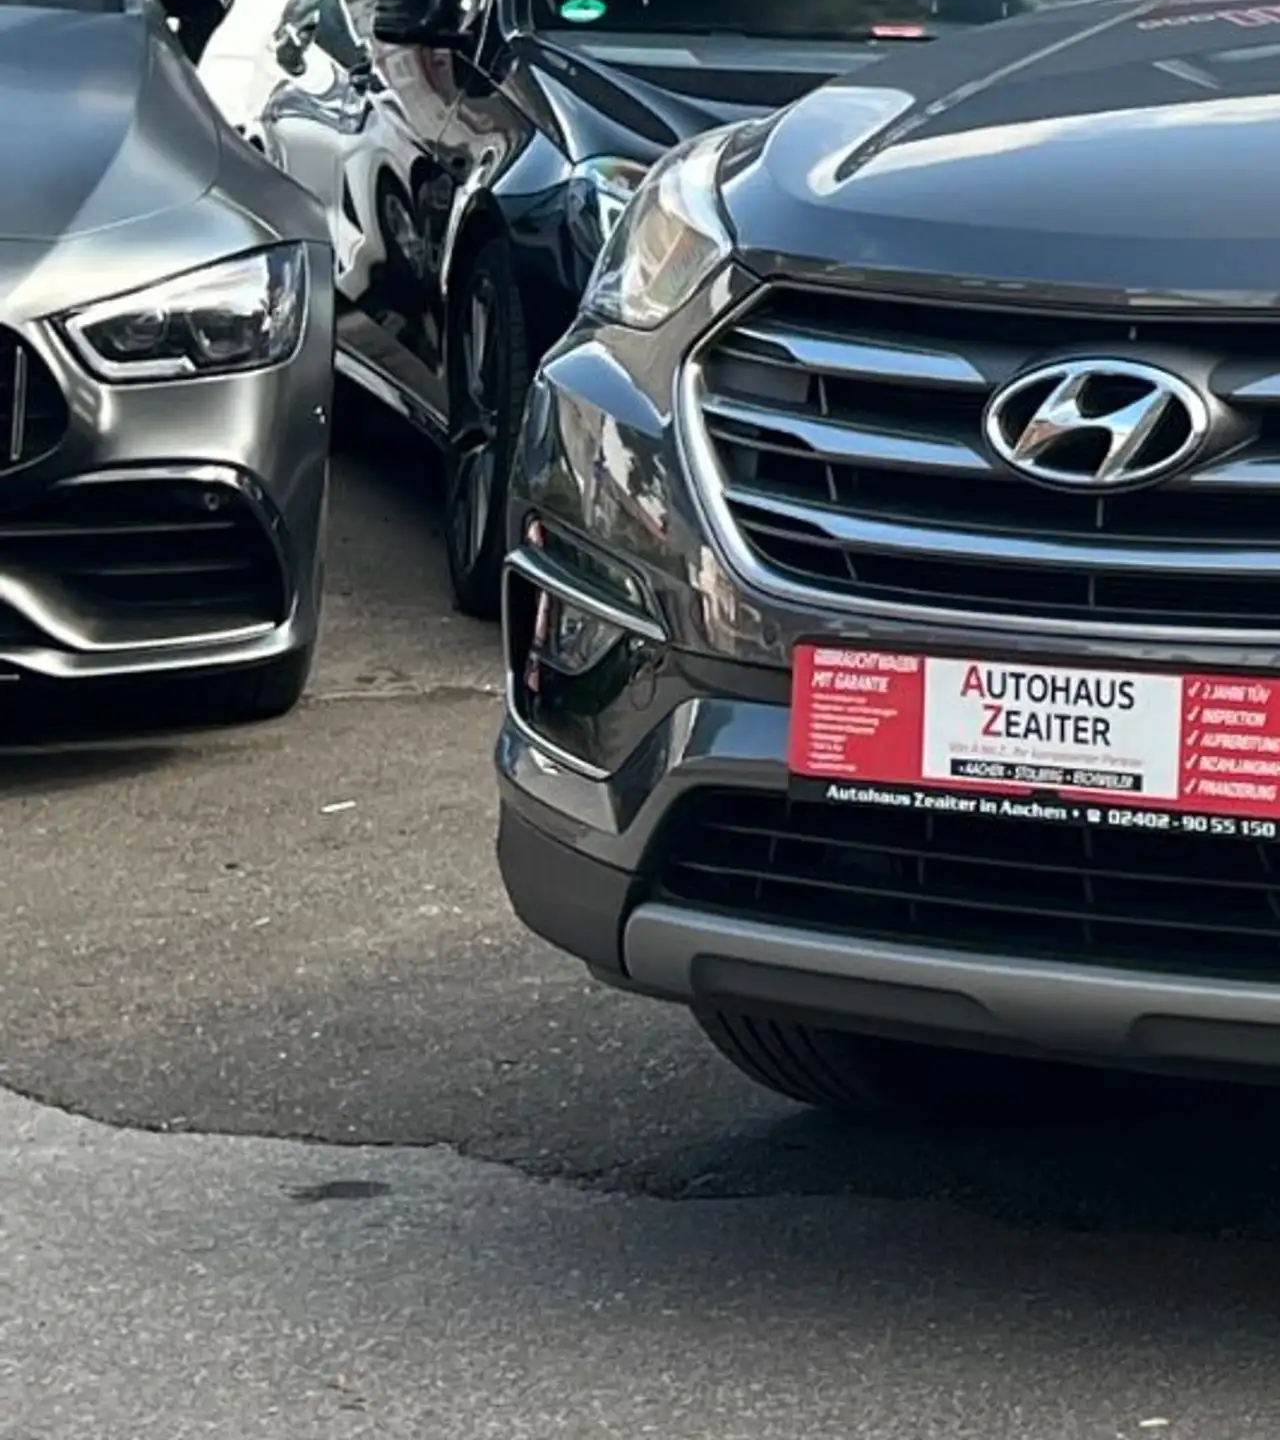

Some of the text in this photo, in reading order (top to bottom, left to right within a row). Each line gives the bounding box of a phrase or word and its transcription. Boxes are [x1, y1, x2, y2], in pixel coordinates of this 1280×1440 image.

[960, 664, 1135, 710] AUTOHAUS
[981, 704, 1111, 747] ZEAITER
[826, 784, 911, 806] Autohaus
[914, 791, 978, 812] Zeaiter
[980, 797, 997, 815] in
[1000, 799, 1067, 821] Aachen
[1210, 818, 1236, 835] 55
[1240, 820, 1276, 838] 150
